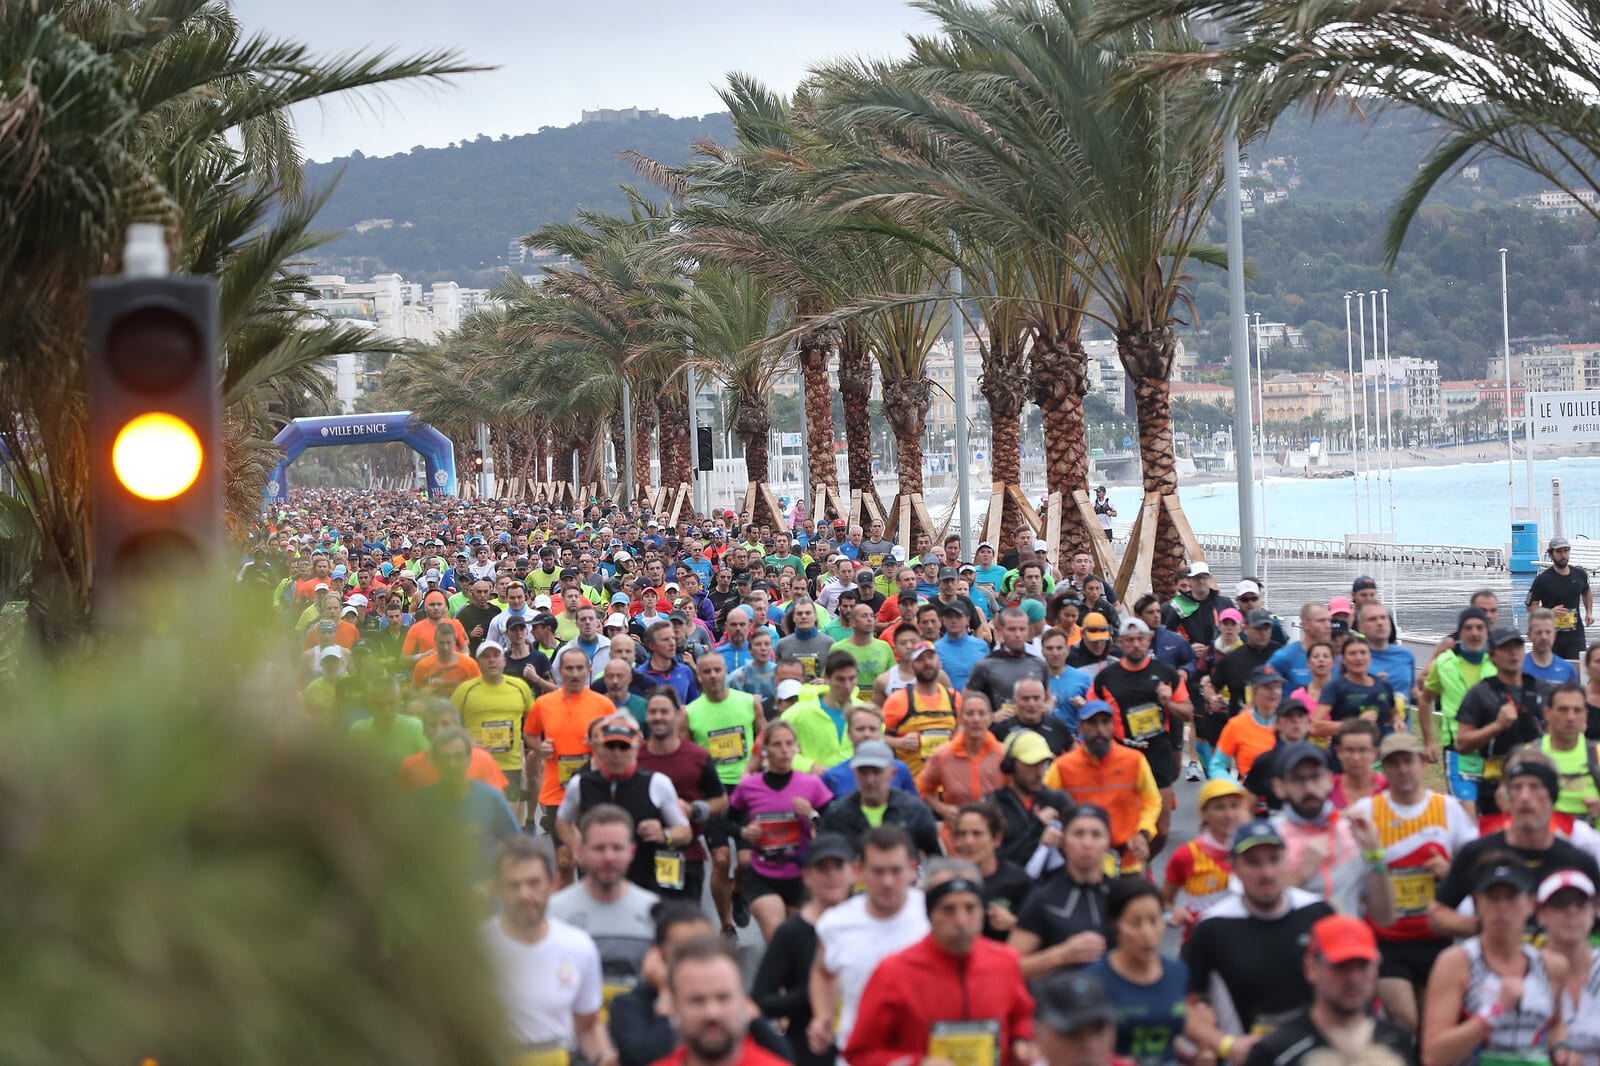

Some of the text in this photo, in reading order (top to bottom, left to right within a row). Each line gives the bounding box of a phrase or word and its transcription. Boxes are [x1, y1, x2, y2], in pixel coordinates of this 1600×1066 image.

[1540, 403, 1551, 418] LE
[329, 423, 387, 436] VILLE DE NICE
[1541, 423, 1600, 433] #BAR #RESTAU
